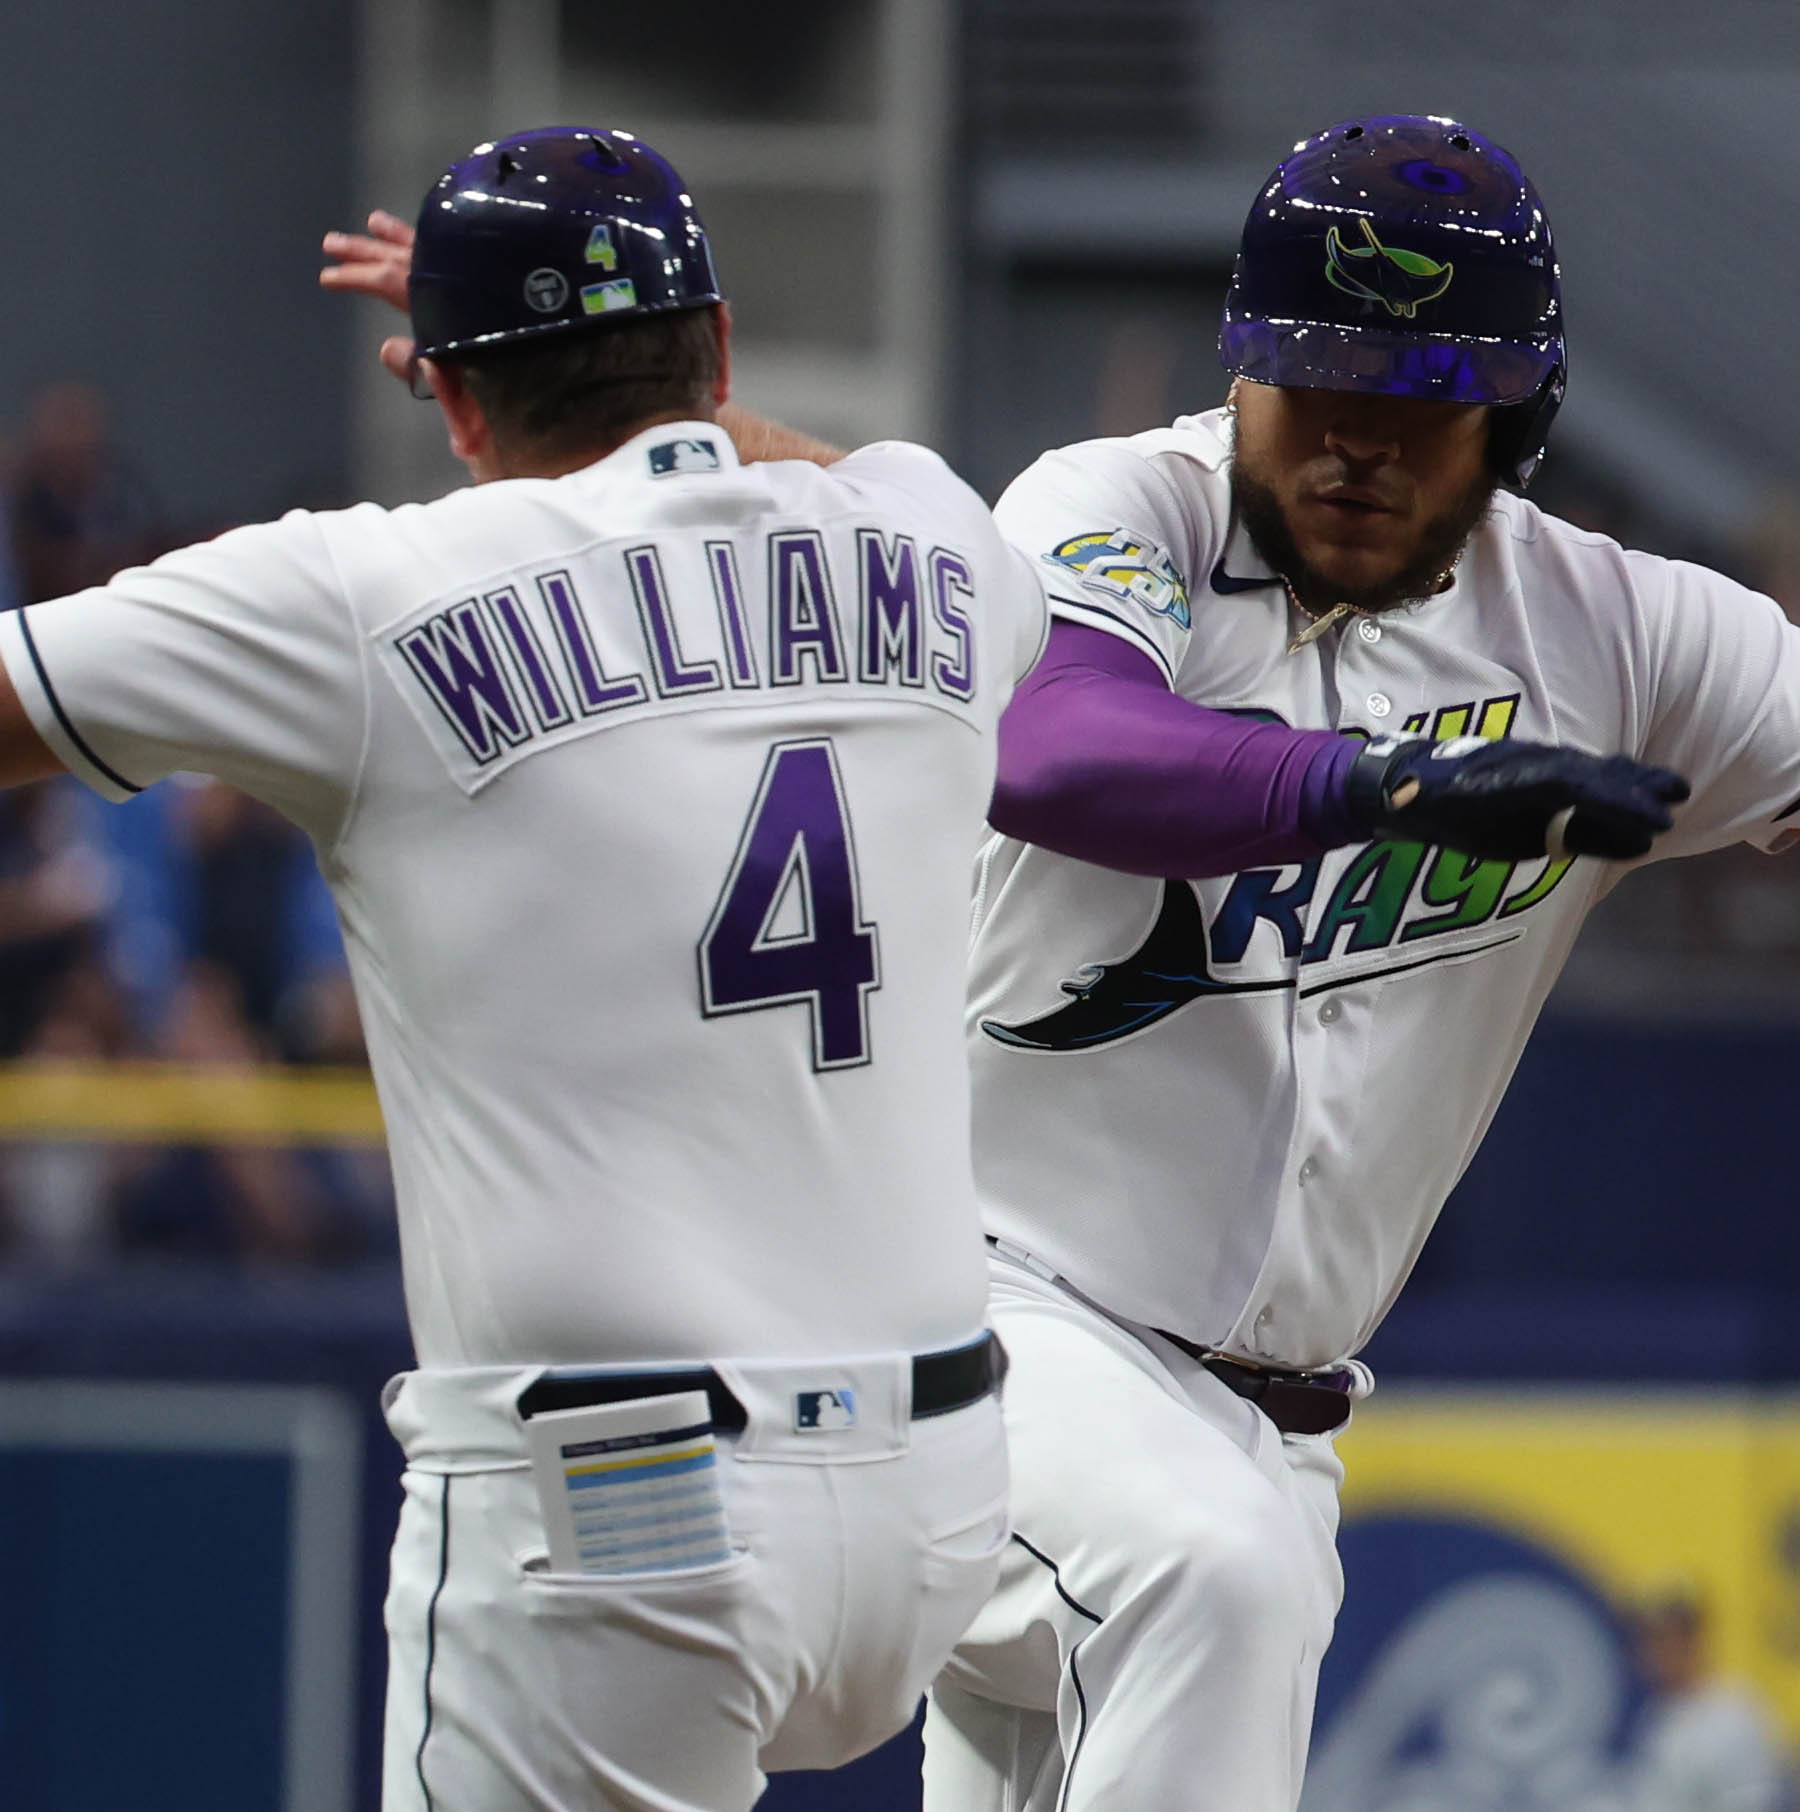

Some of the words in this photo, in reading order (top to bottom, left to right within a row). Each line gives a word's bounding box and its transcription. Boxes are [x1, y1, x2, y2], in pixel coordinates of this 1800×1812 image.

[585, 224, 618, 272] 4
[394, 527, 976, 765] WILLIAMS
[1080, 527, 1180, 617] 25
[696, 736, 883, 1073] 4
